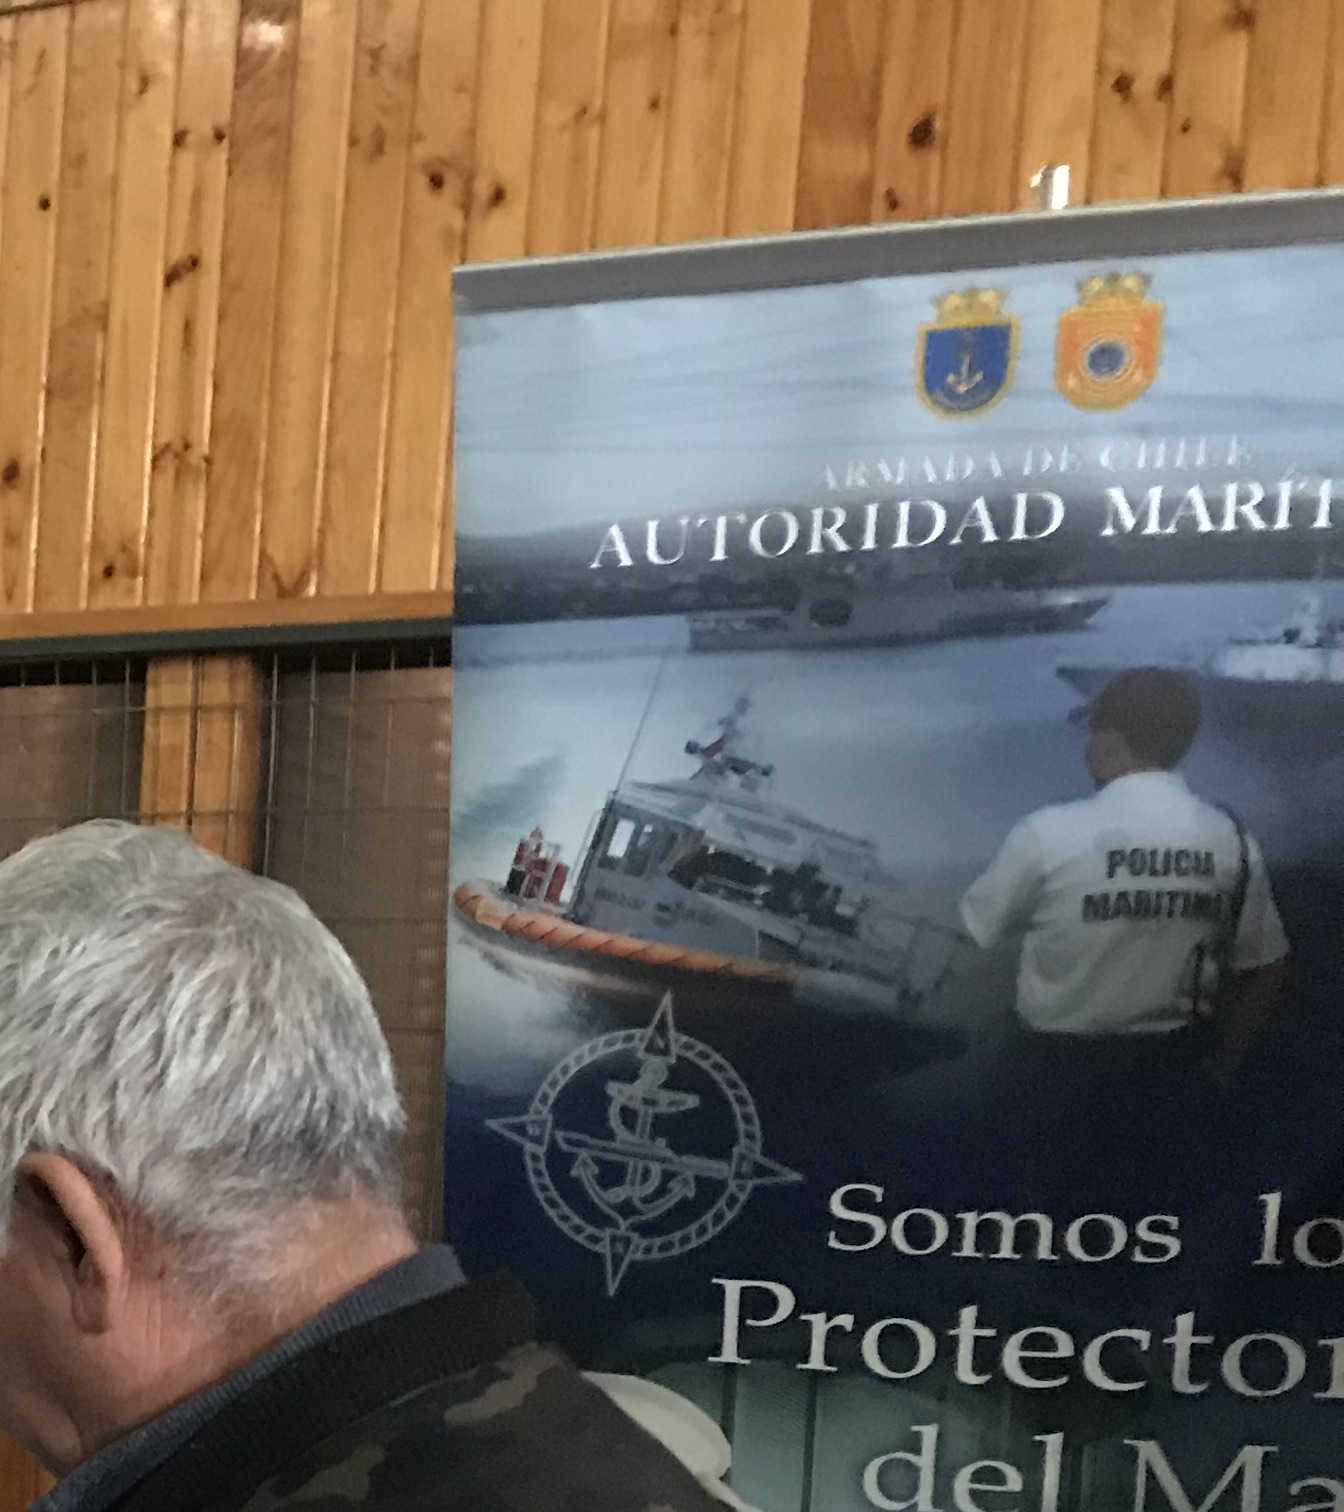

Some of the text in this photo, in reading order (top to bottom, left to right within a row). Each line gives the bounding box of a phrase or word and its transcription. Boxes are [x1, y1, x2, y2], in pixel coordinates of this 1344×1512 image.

[590, 463, 1343, 571] AUTORIDAD MARÍT
[827, 1183, 1344, 1268] Somos lo
